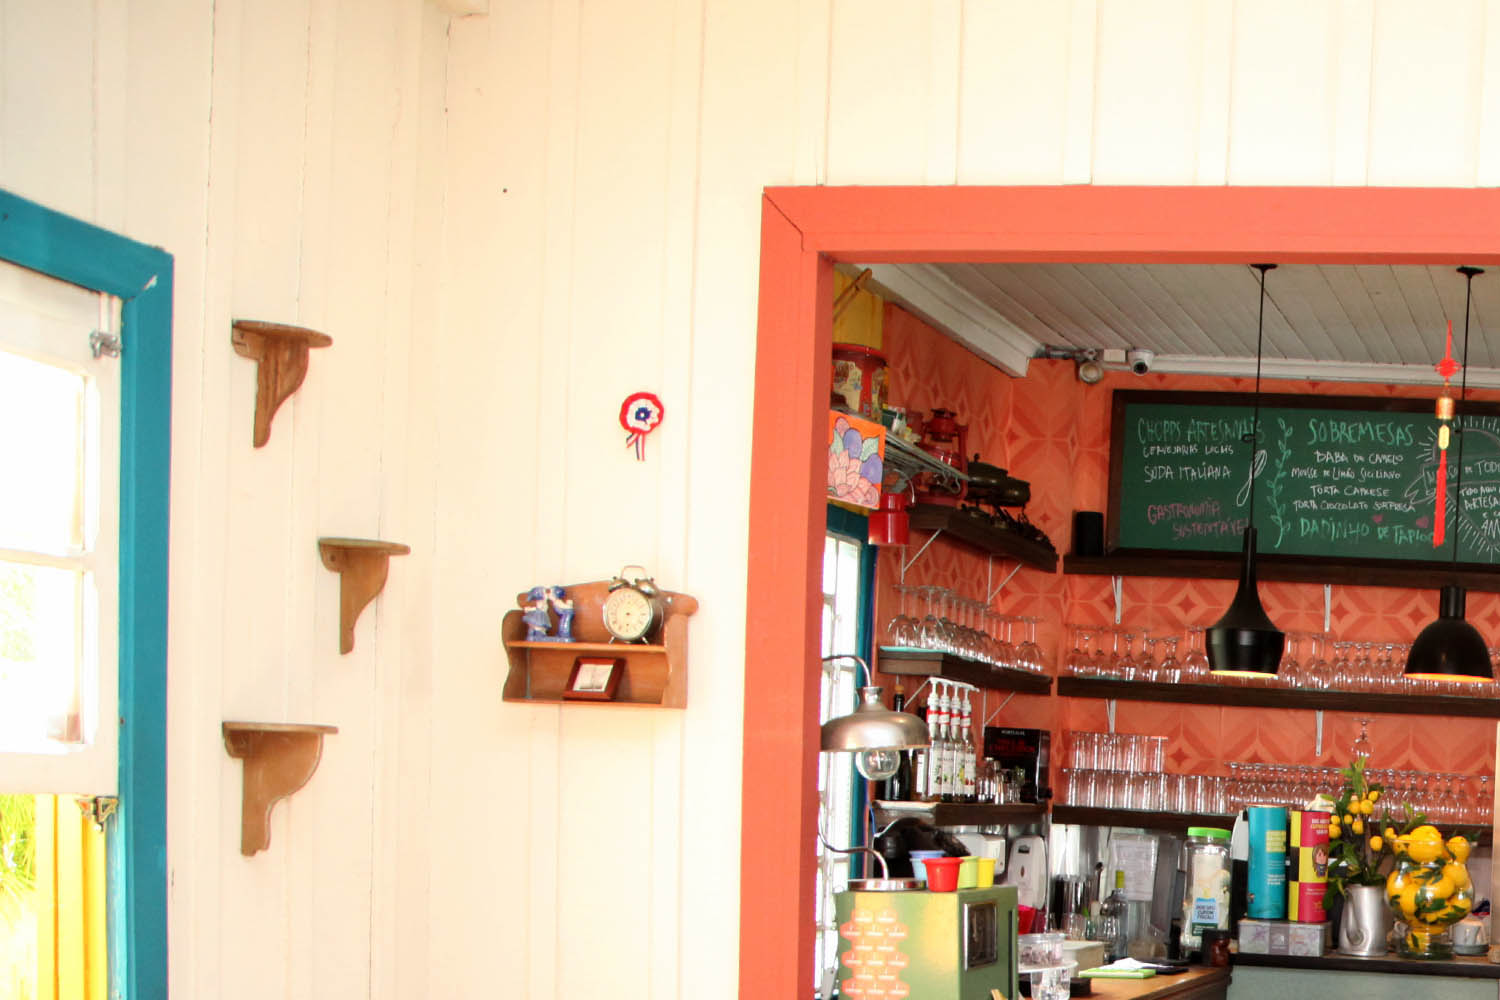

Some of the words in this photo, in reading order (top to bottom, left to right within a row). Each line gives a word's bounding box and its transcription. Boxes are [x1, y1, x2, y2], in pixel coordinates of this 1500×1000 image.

[1307, 418, 1414, 447] SOBREMESAS
[1368, 452, 1405, 465] CAMELO
[1144, 465, 1174, 483] SODA
[1179, 461, 1232, 481] ITALIANA
[1291, 466, 1318, 480] MOUSSE
[1358, 466, 1401, 483] SICILIANO
[1310, 483, 1340, 498] TORTA
[1343, 485, 1392, 497] CAPRESE
[1292, 500, 1318, 512] TORTA
[1300, 518, 1370, 541] DADINHO
[1377, 526, 1390, 540] DE
